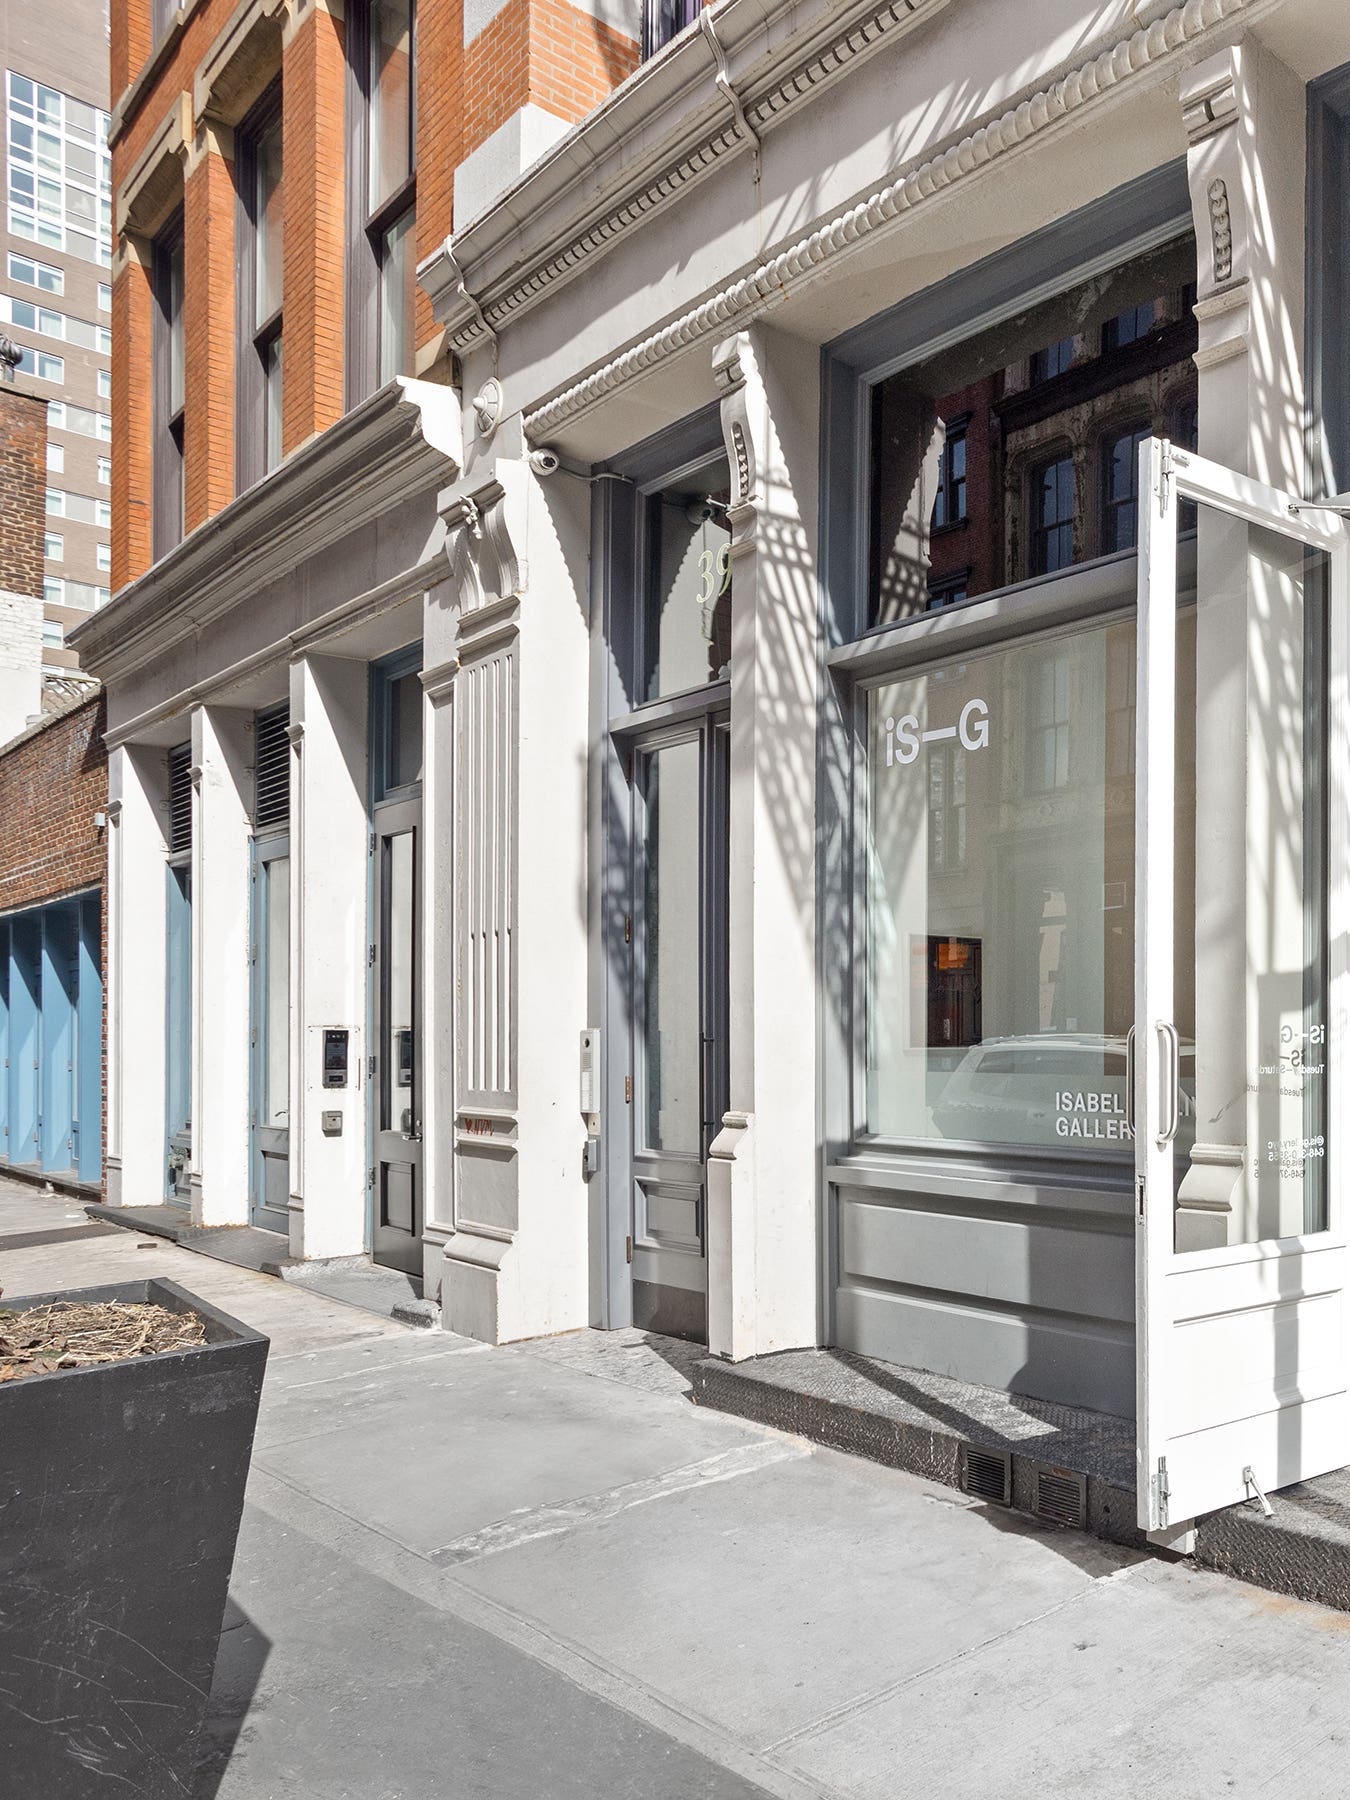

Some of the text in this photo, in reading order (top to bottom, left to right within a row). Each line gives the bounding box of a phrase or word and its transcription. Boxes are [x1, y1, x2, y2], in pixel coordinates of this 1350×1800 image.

[696, 542, 733, 603] 39
[1055, 1091, 1124, 1114] ISABEL
[1055, 1116, 1132, 1140] GALLER
